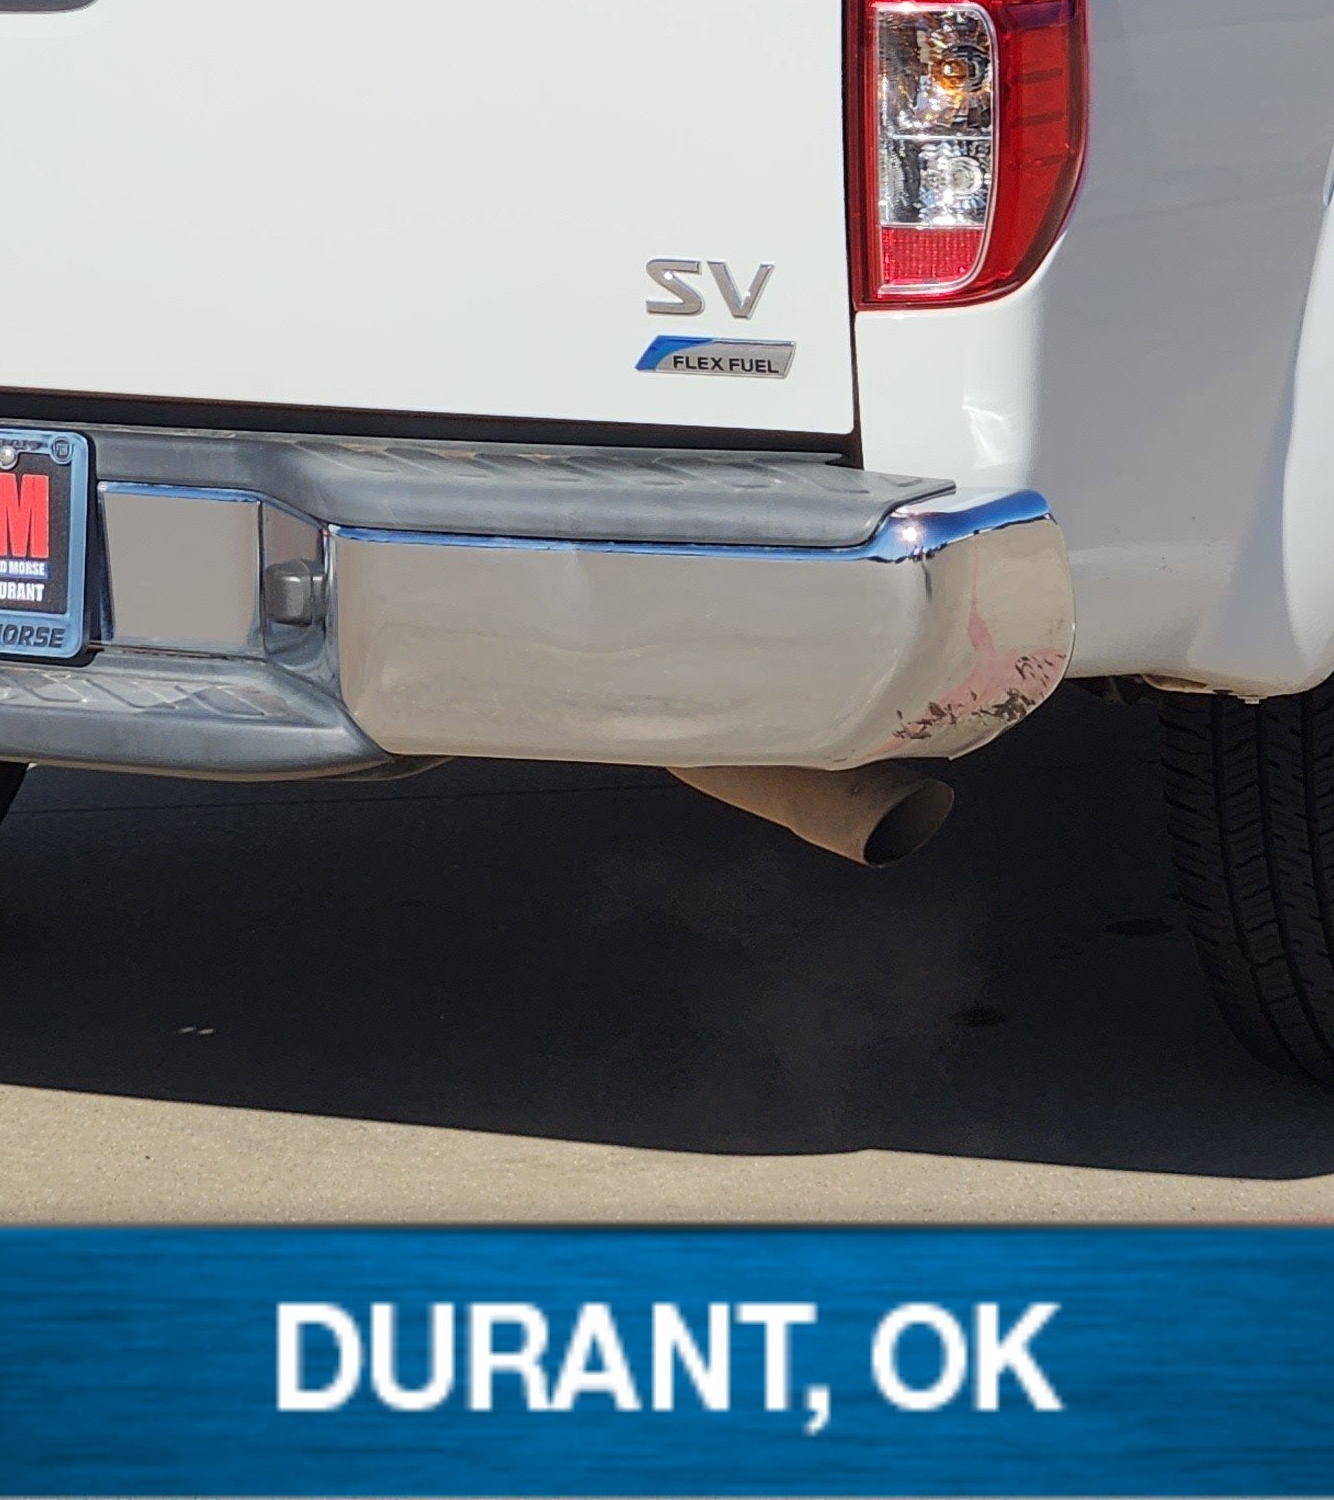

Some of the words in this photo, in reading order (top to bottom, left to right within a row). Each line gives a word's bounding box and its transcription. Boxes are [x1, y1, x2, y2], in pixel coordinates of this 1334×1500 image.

[645, 258, 776, 320] SV
[672, 355, 723, 371] FLEX
[729, 357, 779, 374] FUEL
[8, 561, 46, 576] MORSE
